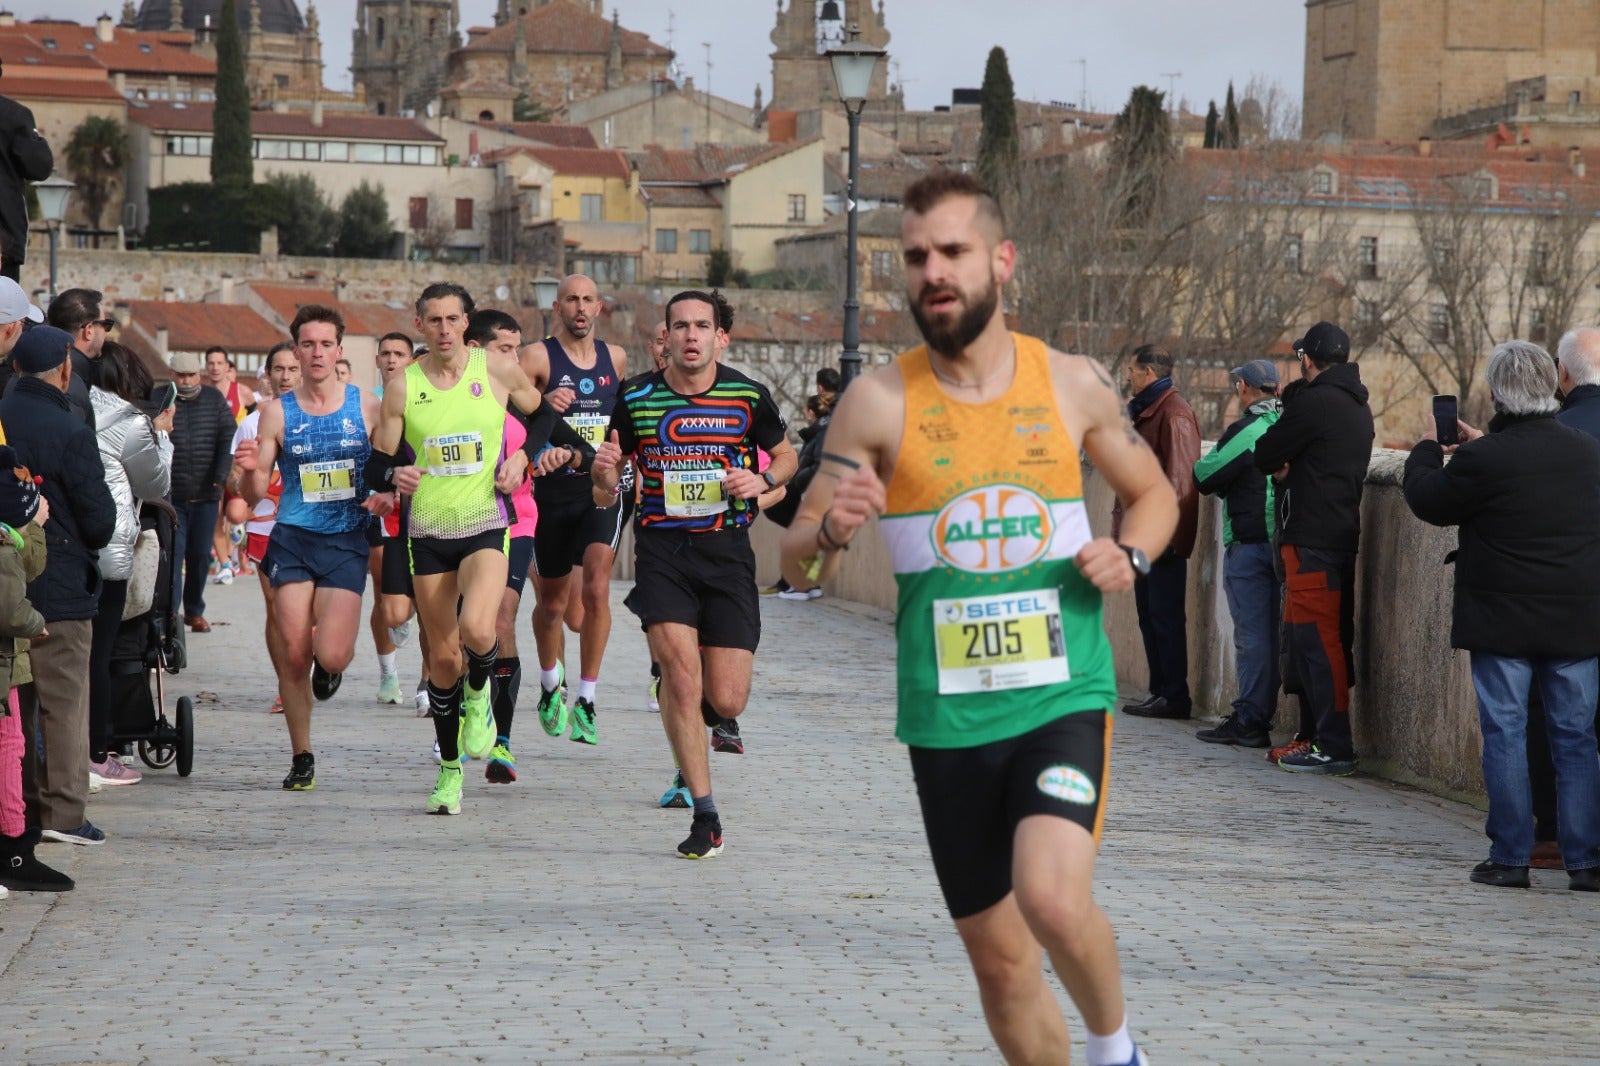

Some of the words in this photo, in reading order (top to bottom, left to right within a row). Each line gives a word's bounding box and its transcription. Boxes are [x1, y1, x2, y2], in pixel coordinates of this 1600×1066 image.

[680, 418, 726, 428] XXXVIII
[438, 435, 476, 445] SETEL
[442, 445, 460, 462] 90
[663, 445, 725, 456] SILVESTRE
[313, 462, 349, 472] SETEL
[319, 472, 332, 488] 71
[680, 473, 721, 482] SETEL
[680, 483, 705, 501] 132
[944, 515, 1044, 544] ALCER
[966, 597, 1047, 619] SETEL
[962, 620, 1022, 659] 205
